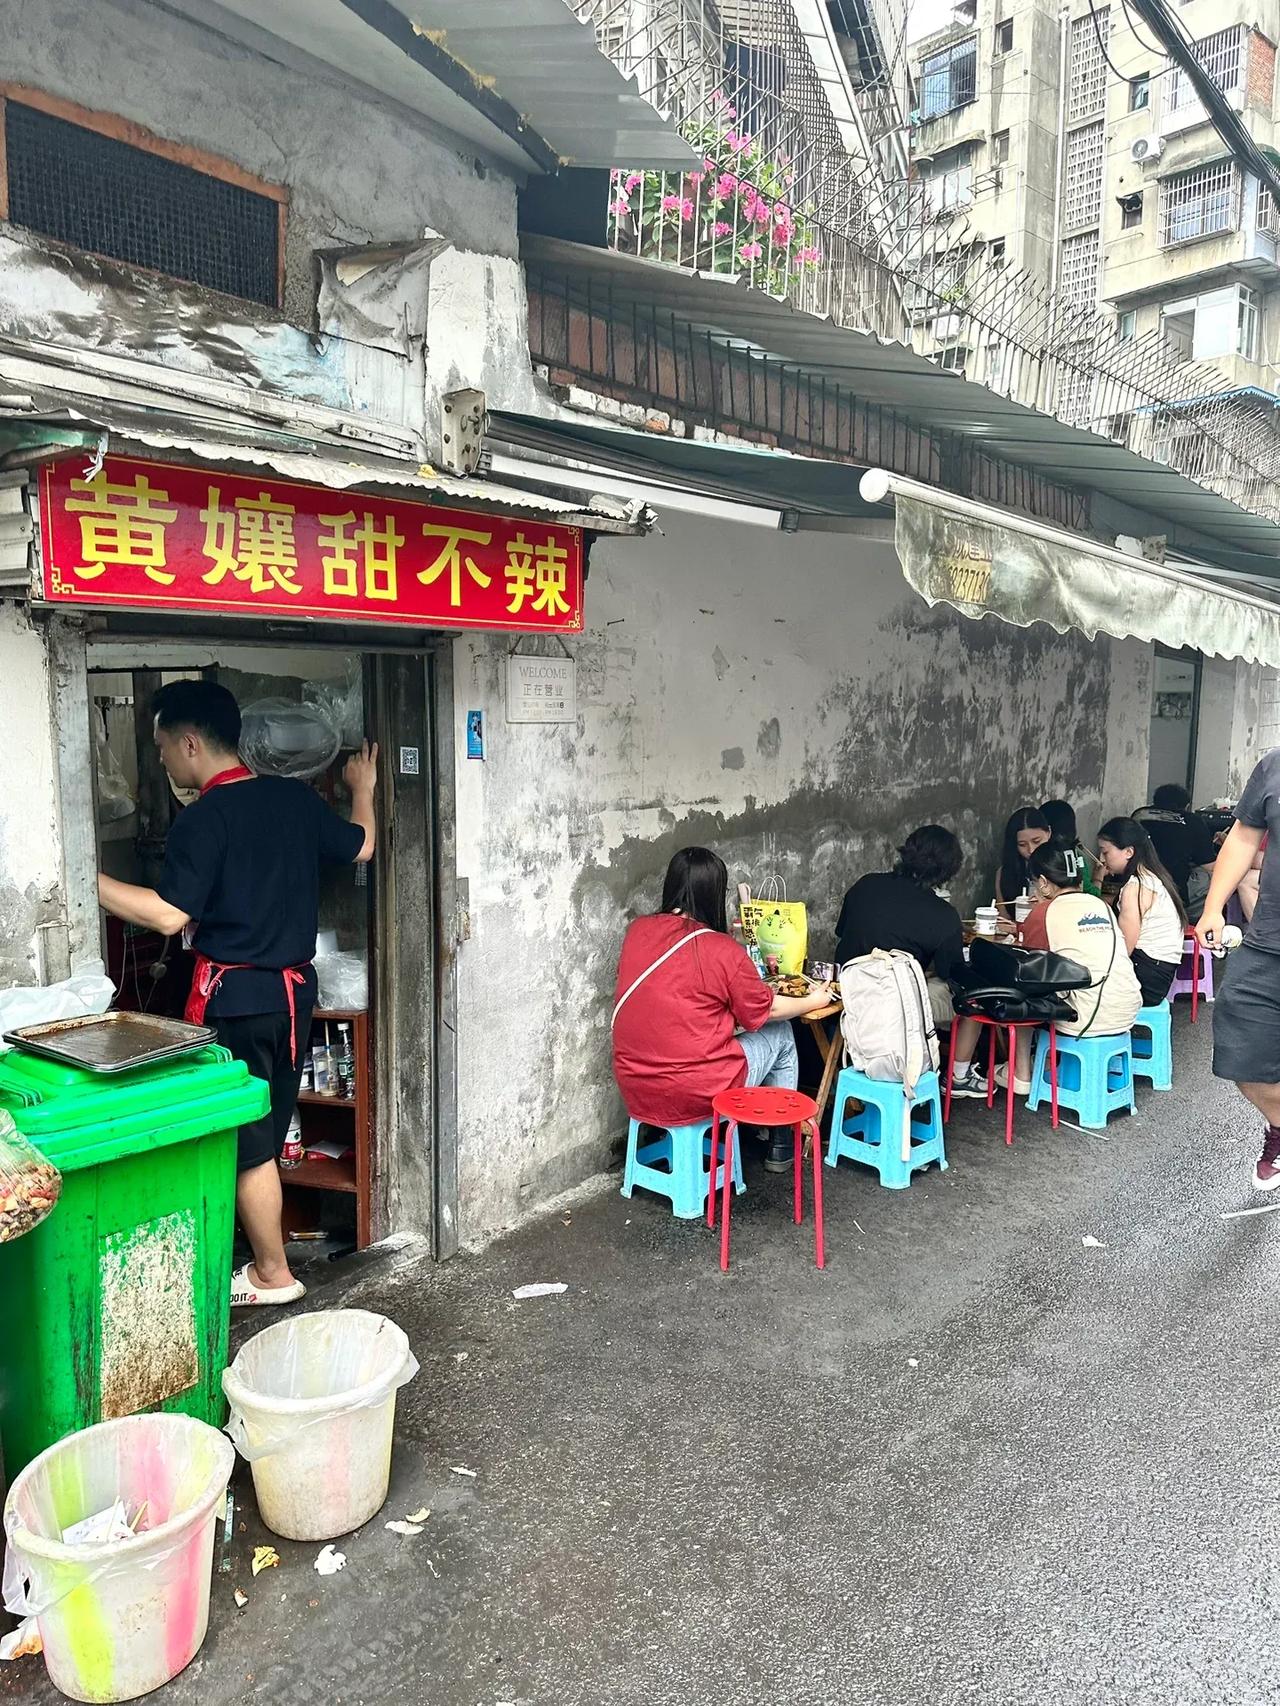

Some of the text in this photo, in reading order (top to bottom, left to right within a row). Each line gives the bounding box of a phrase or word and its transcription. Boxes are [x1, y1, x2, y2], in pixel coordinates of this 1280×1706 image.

[65, 473, 571, 618] 黄孃甜不辣
[518, 666, 568, 679] WELCOME
[522, 683, 564, 697] 正在营业
